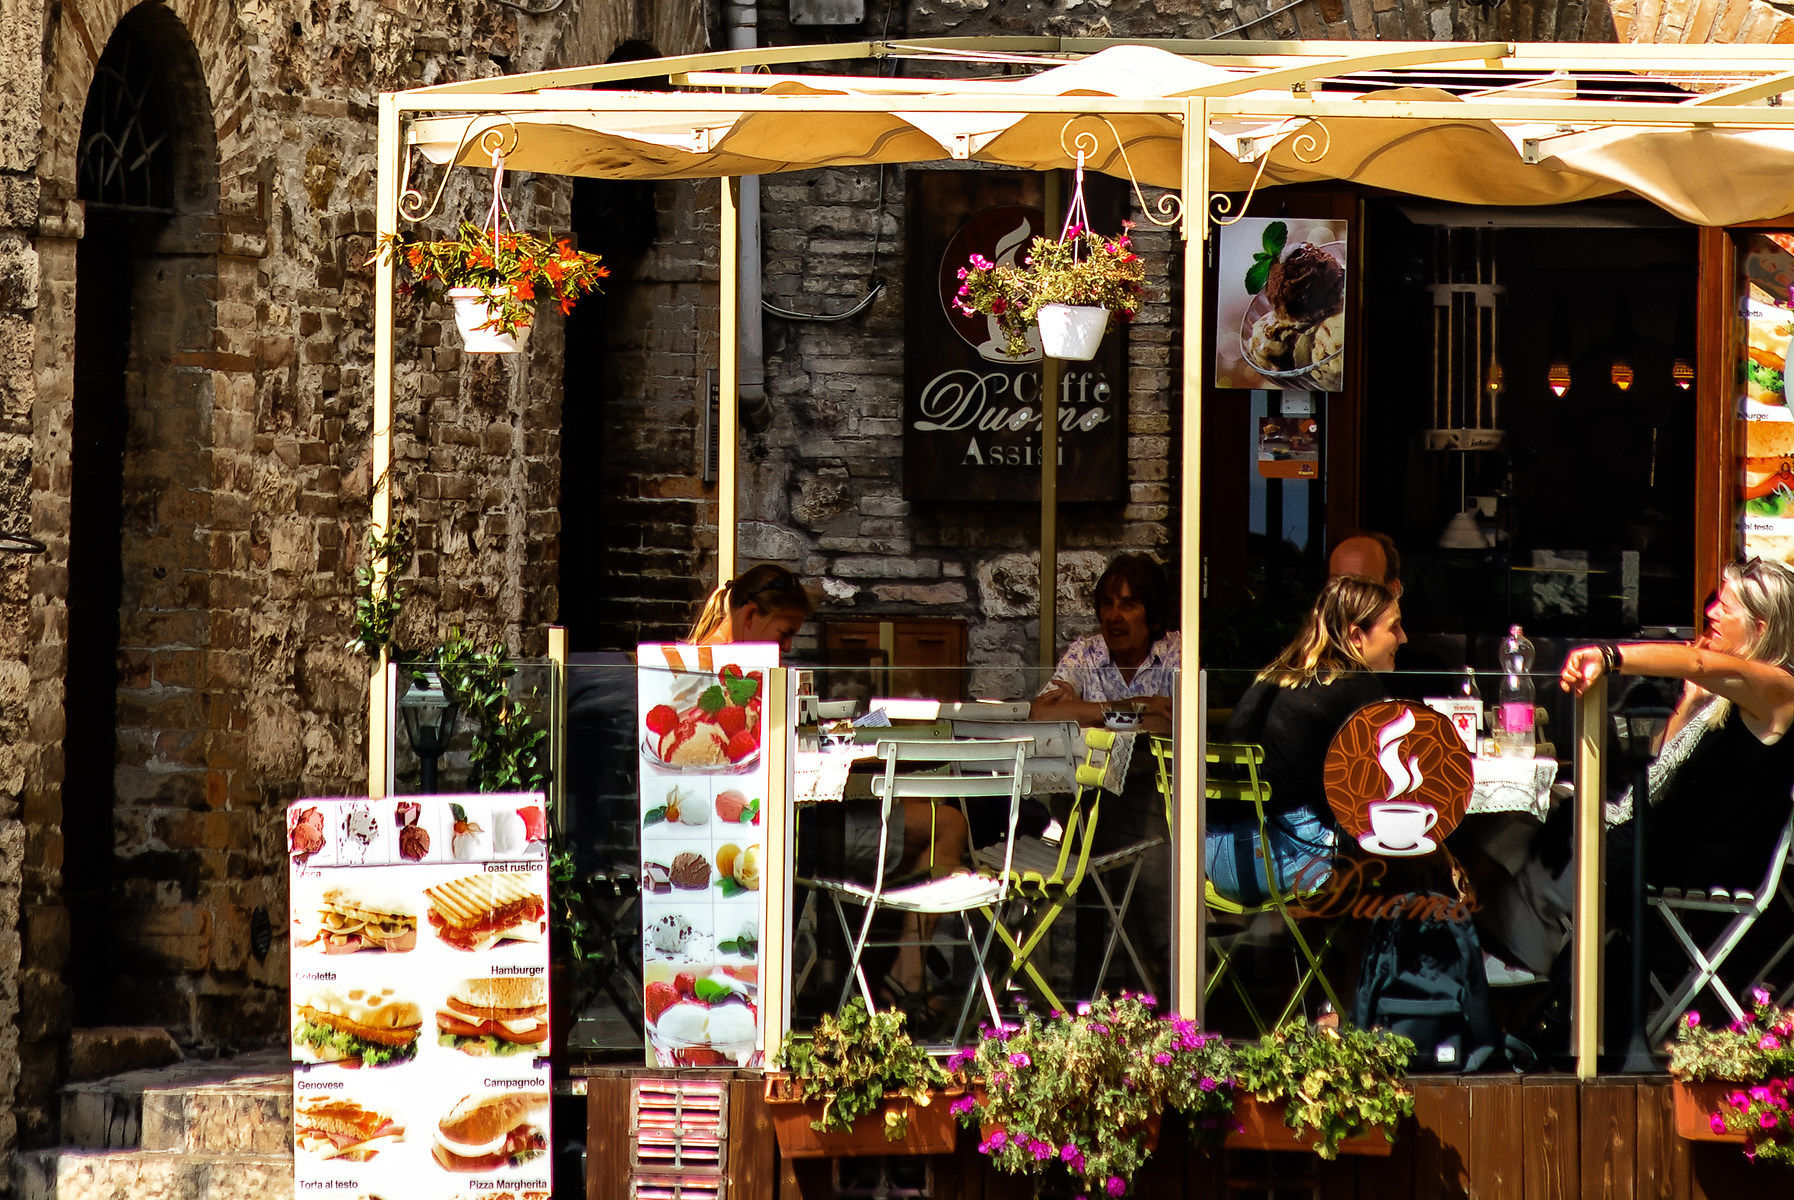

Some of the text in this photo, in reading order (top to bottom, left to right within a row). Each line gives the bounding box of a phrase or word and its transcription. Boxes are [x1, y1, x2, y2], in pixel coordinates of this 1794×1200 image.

[1013, 370, 1111, 402] Cffè
[961, 436, 1064, 466] Assii
[482, 861, 543, 873] Toast rustico
[1287, 854, 1485, 923] Duomo
[491, 965, 545, 977] Hamburger
[297, 1080, 344, 1090] Genovese
[483, 1077, 545, 1089] Campagnolo
[299, 1179, 359, 1190] Torta al testo
[469, 1179, 547, 1191] Pizza Margherita
